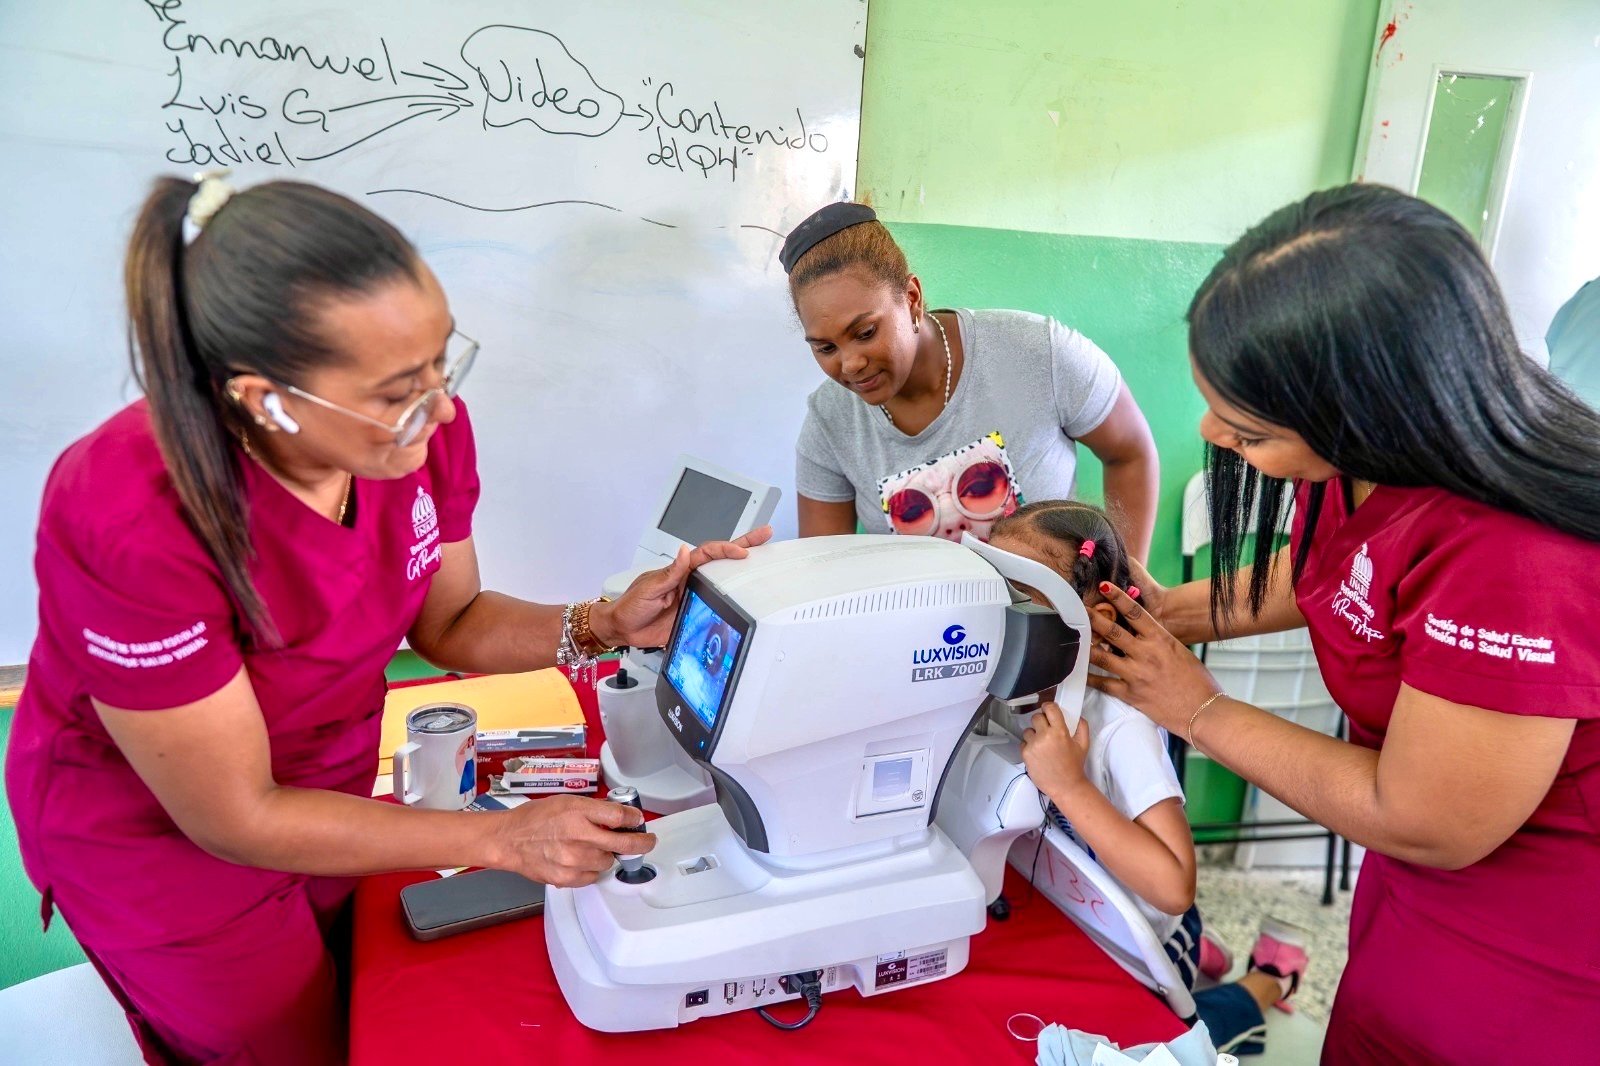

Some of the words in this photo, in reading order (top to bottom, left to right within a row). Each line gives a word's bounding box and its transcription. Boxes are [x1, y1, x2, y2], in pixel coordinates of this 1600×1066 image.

[161, 56, 267, 119] Luis
[282, 88, 329, 132] G
[477, 57, 600, 118] Video
[647, 126, 684, 172] del
[1460, 625, 1475, 637] de
[1477, 628, 1510, 645] Salud
[1511, 634, 1553, 650] Escolar
[913, 643, 990, 665] LUXVISION
[1459, 638, 1475, 651] de
[1478, 641, 1513, 659] Salud
[1517, 647, 1556, 665] Visual
[915, 666, 944, 681] LRK
[951, 661, 984, 677] 7000
[878, 966, 906, 978] LUXVISION
